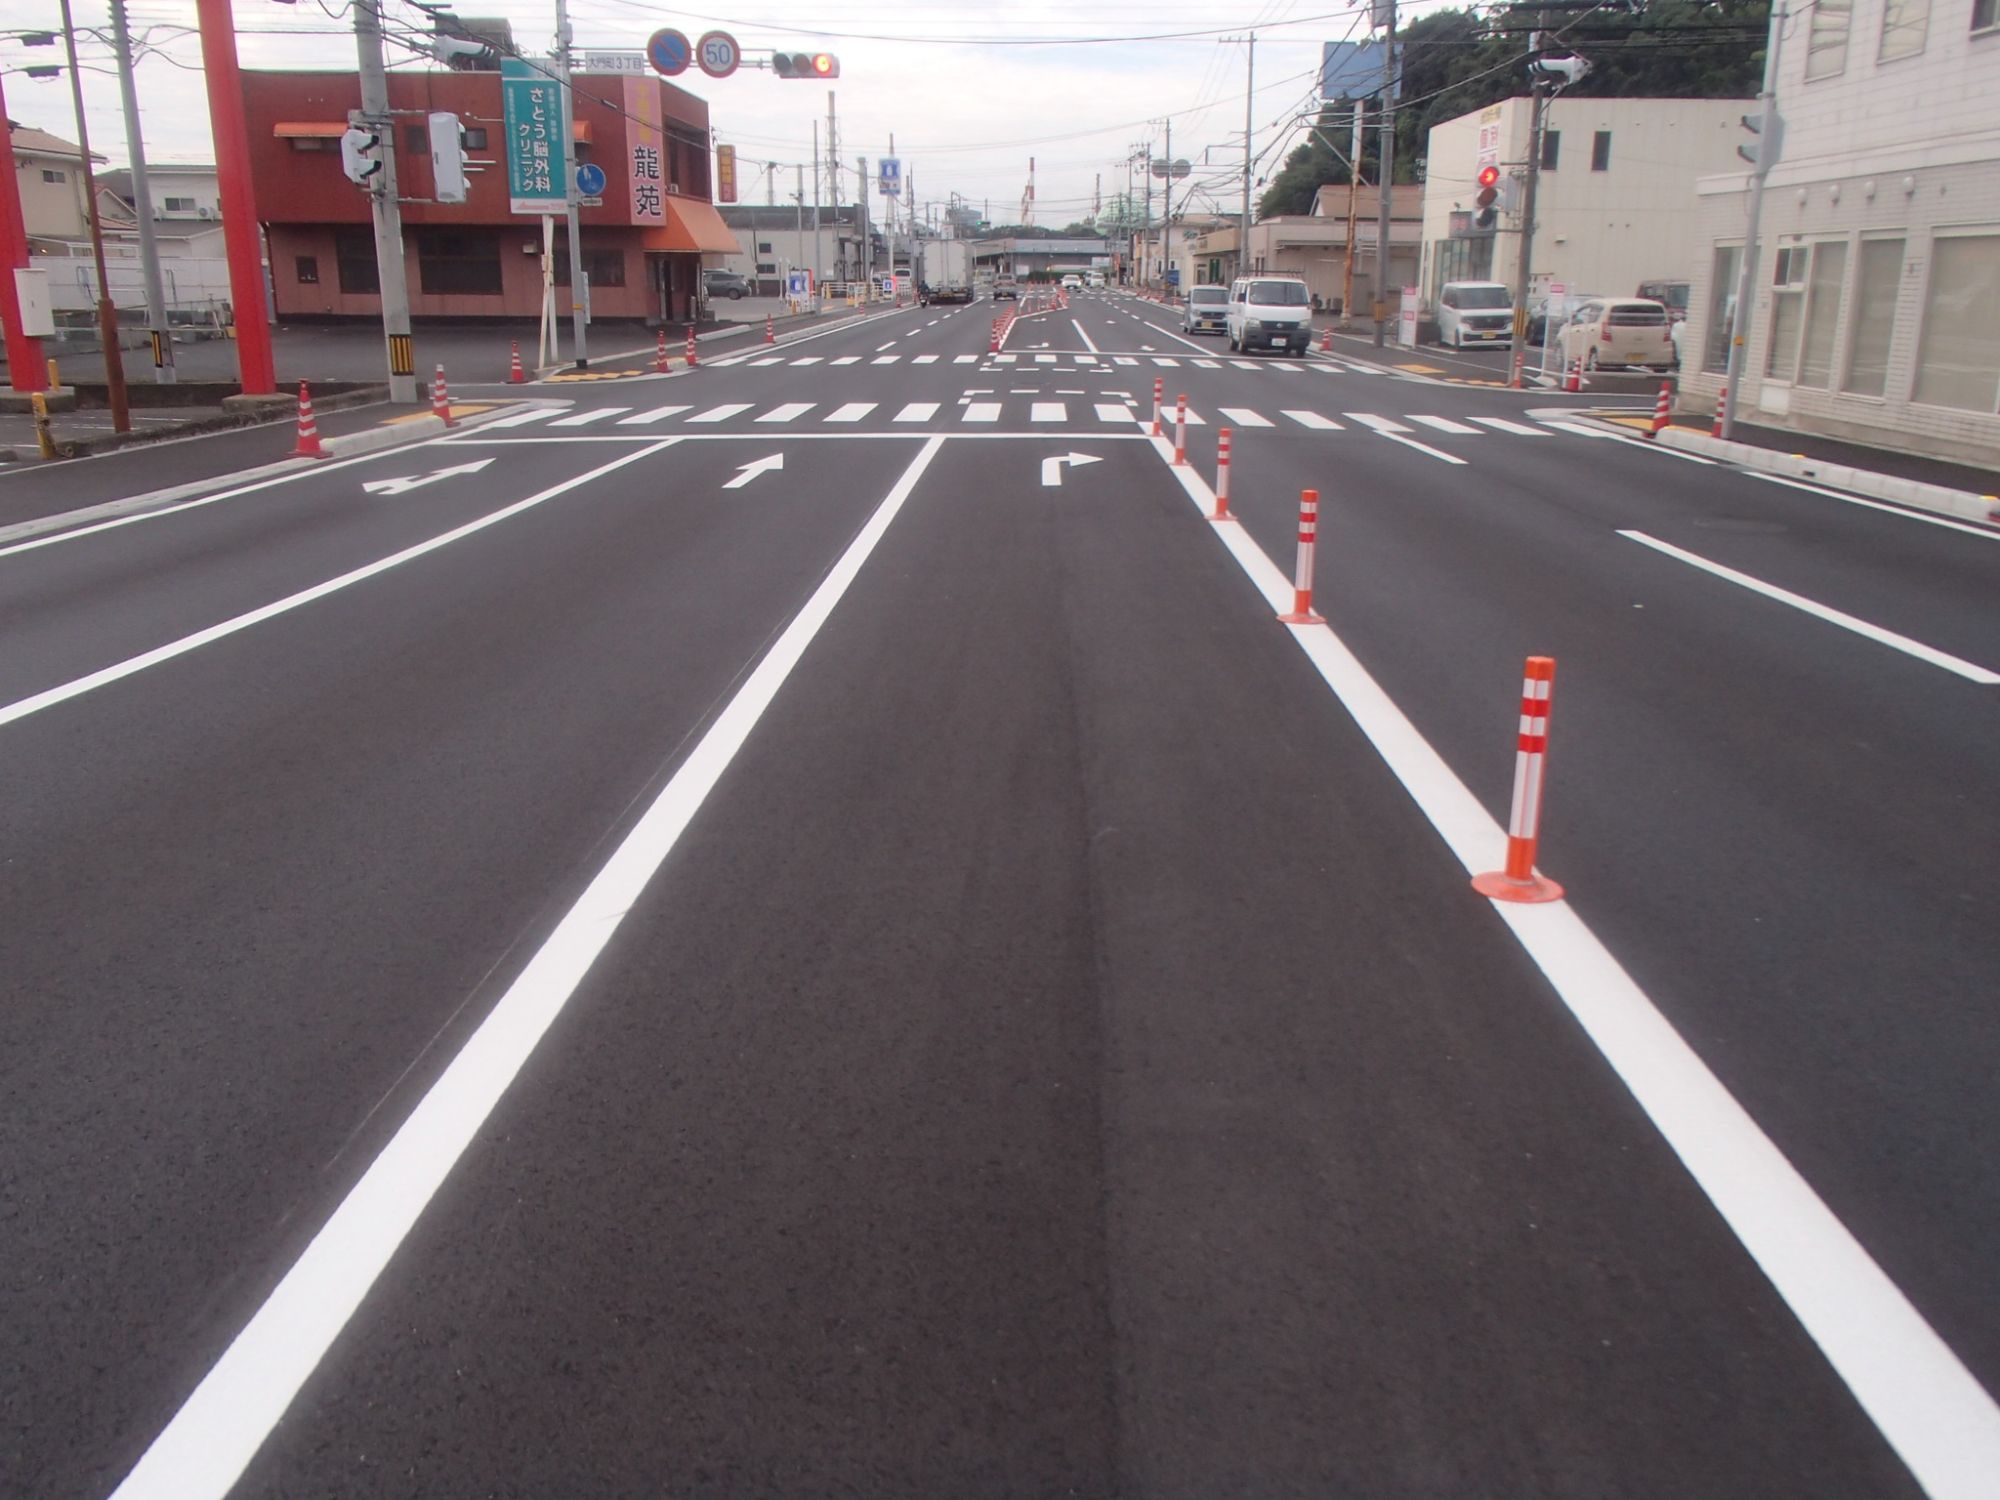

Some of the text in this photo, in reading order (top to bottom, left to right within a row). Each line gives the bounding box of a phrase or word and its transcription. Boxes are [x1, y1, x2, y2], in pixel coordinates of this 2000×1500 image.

[706, 43, 731, 65] 50
[519, 123, 534, 192] クリニック
[530, 87, 551, 193] さとう脳外科
[633, 145, 662, 217] 龍苑
